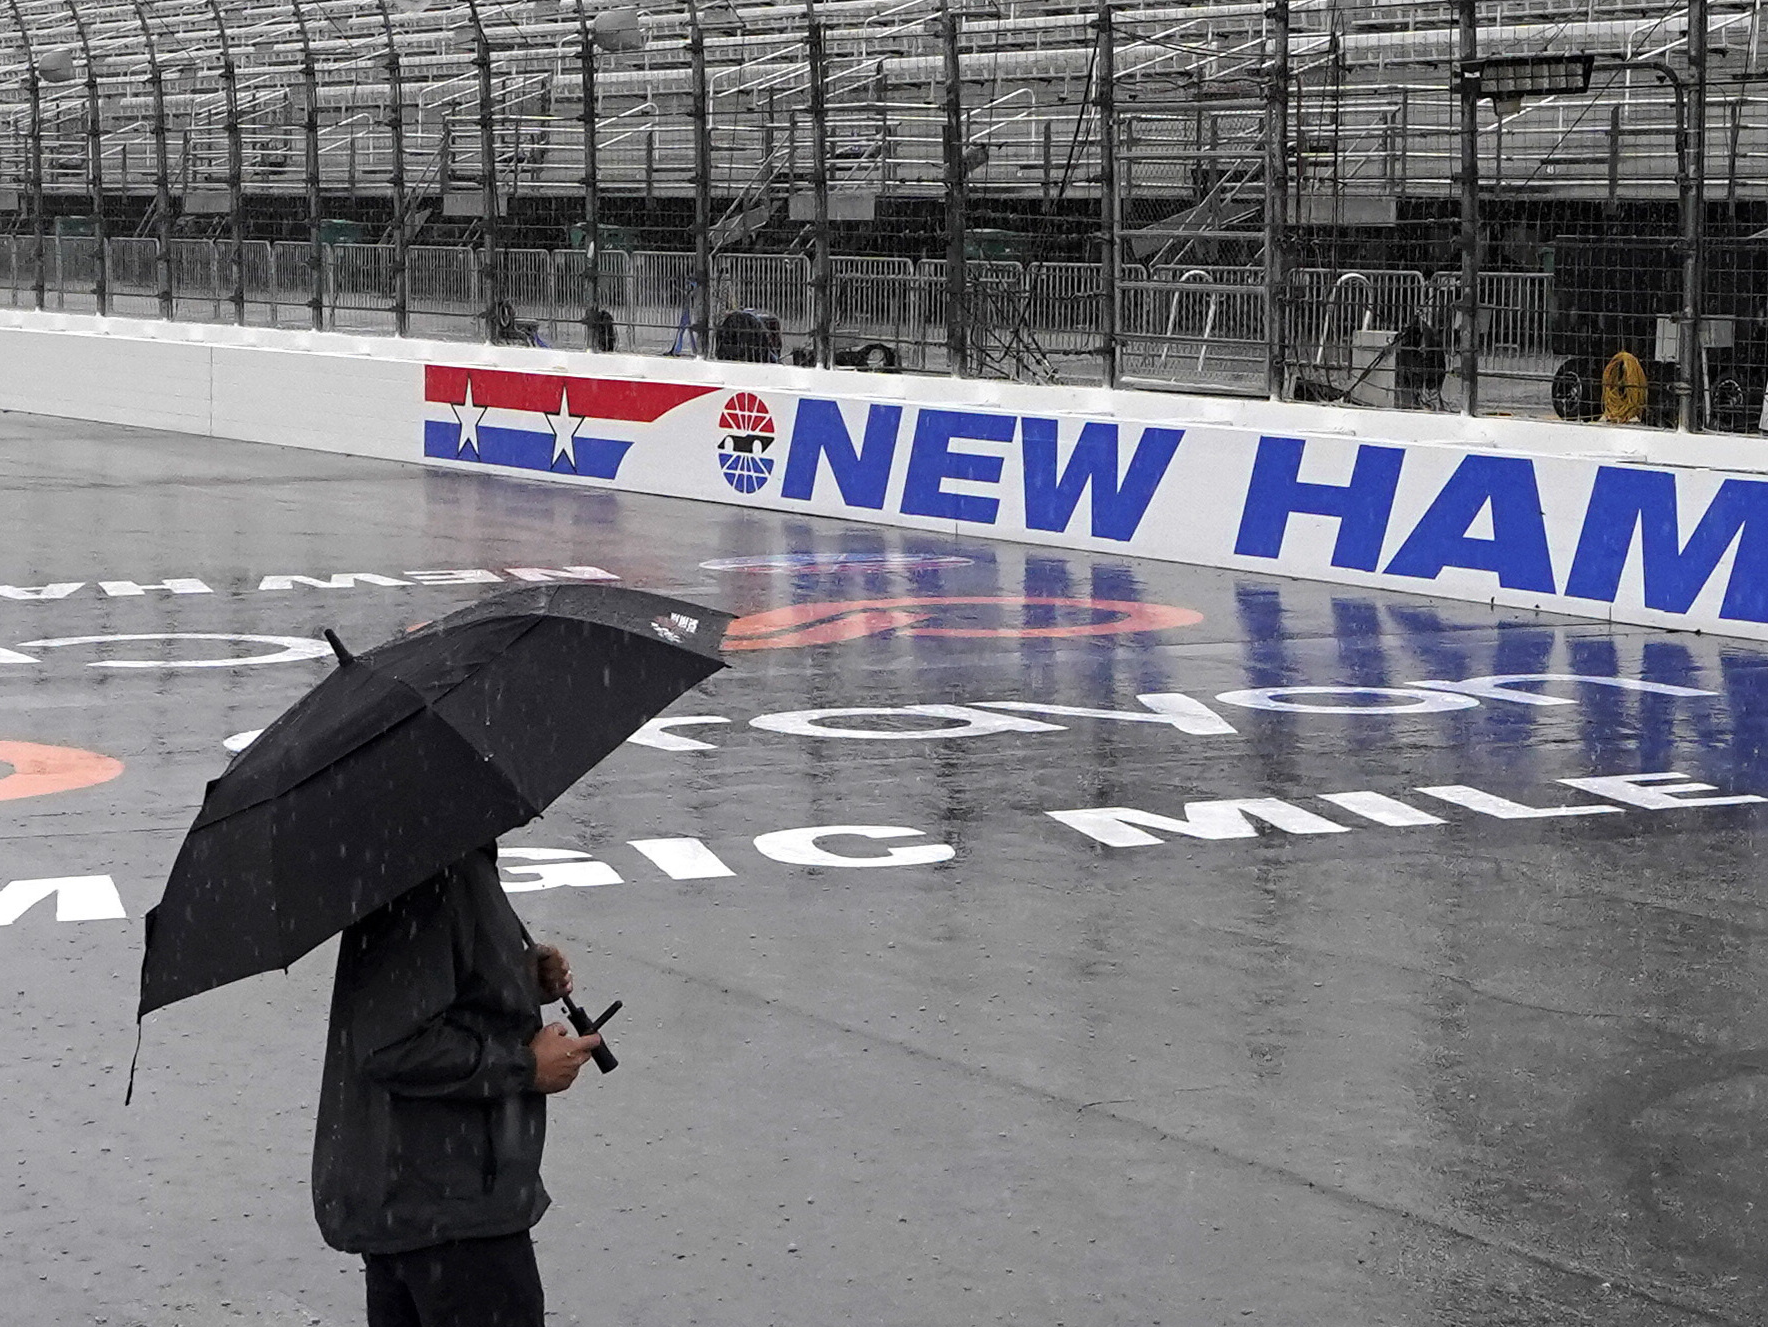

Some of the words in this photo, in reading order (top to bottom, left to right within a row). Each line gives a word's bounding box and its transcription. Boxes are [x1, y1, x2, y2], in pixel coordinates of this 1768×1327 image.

[780, 397, 1186, 543] NEW
[258, 565, 621, 590] NEW
[223, 673, 1721, 753] rayon
